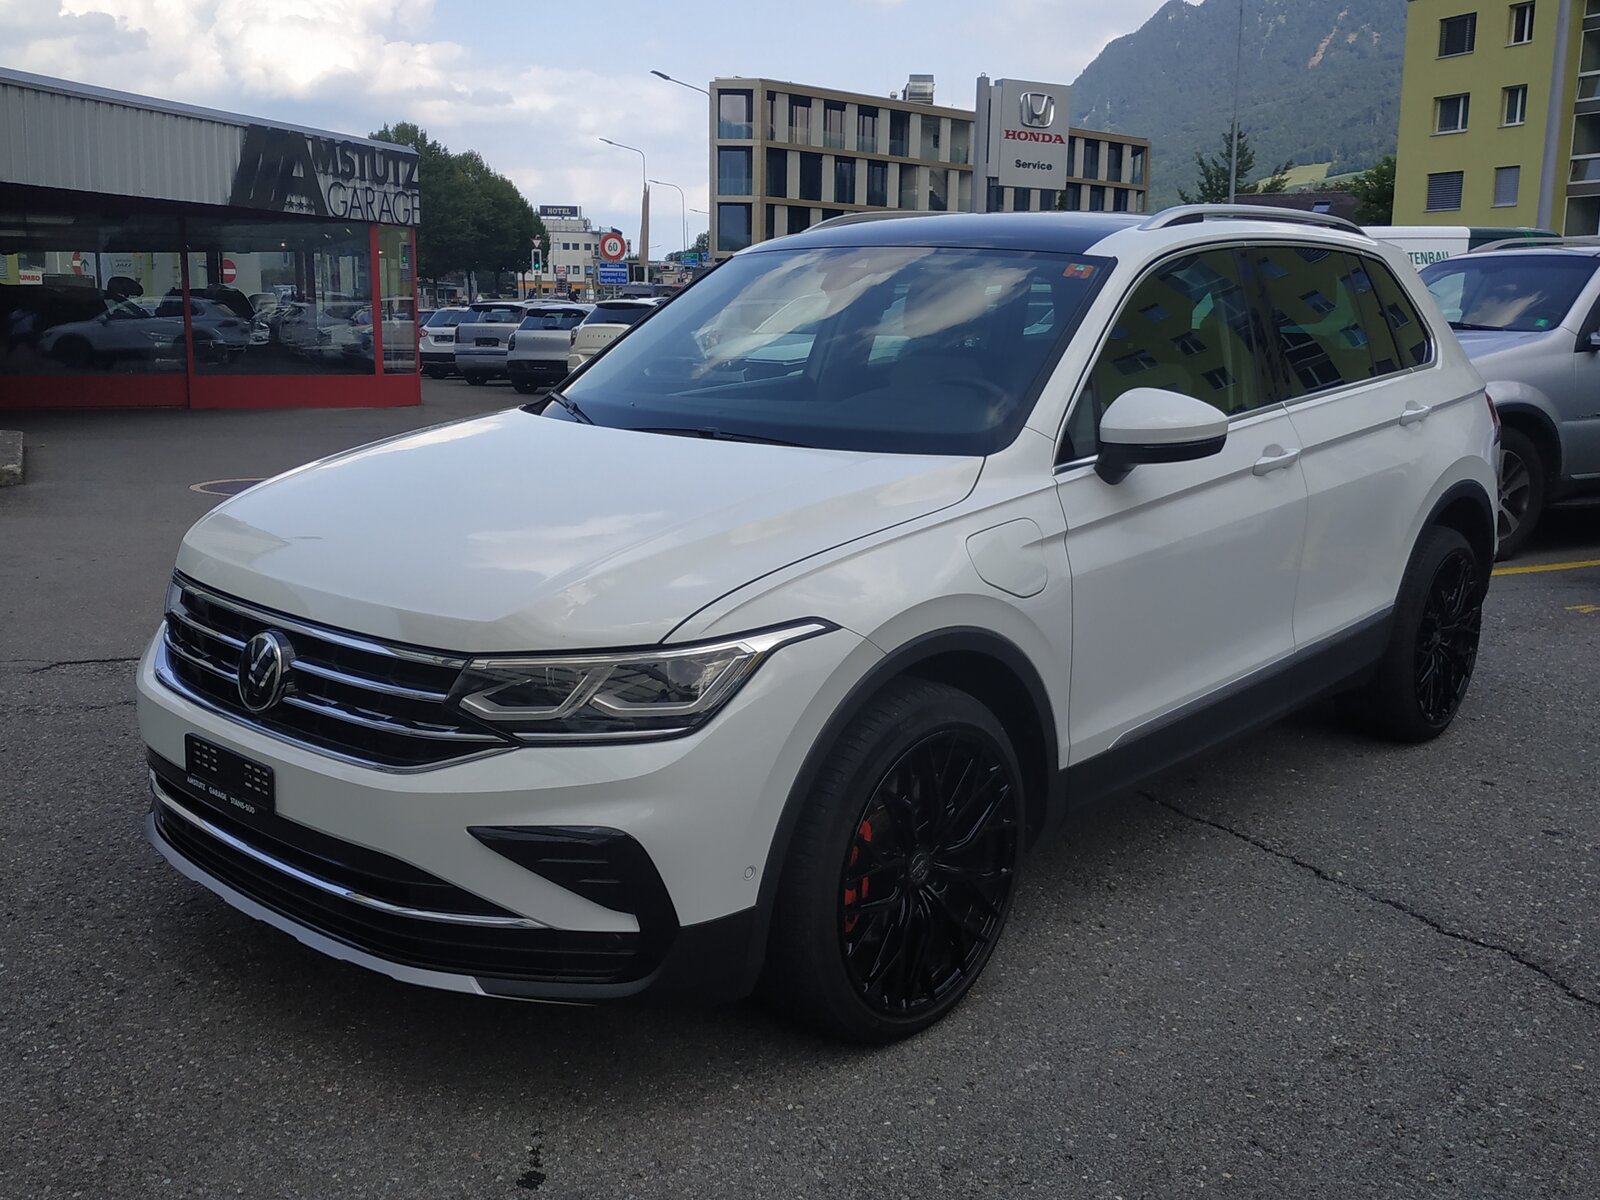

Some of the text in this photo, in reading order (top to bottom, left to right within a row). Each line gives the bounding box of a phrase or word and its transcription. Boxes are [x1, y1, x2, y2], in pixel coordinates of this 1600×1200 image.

[1004, 129, 1066, 145] HONDA
[1015, 159, 1053, 171] Service
[327, 181, 421, 226] GARAGE
[546, 207, 571, 215] HOTEL
[607, 242, 618, 252] 60
[208, 786, 227, 801] GARAGE
